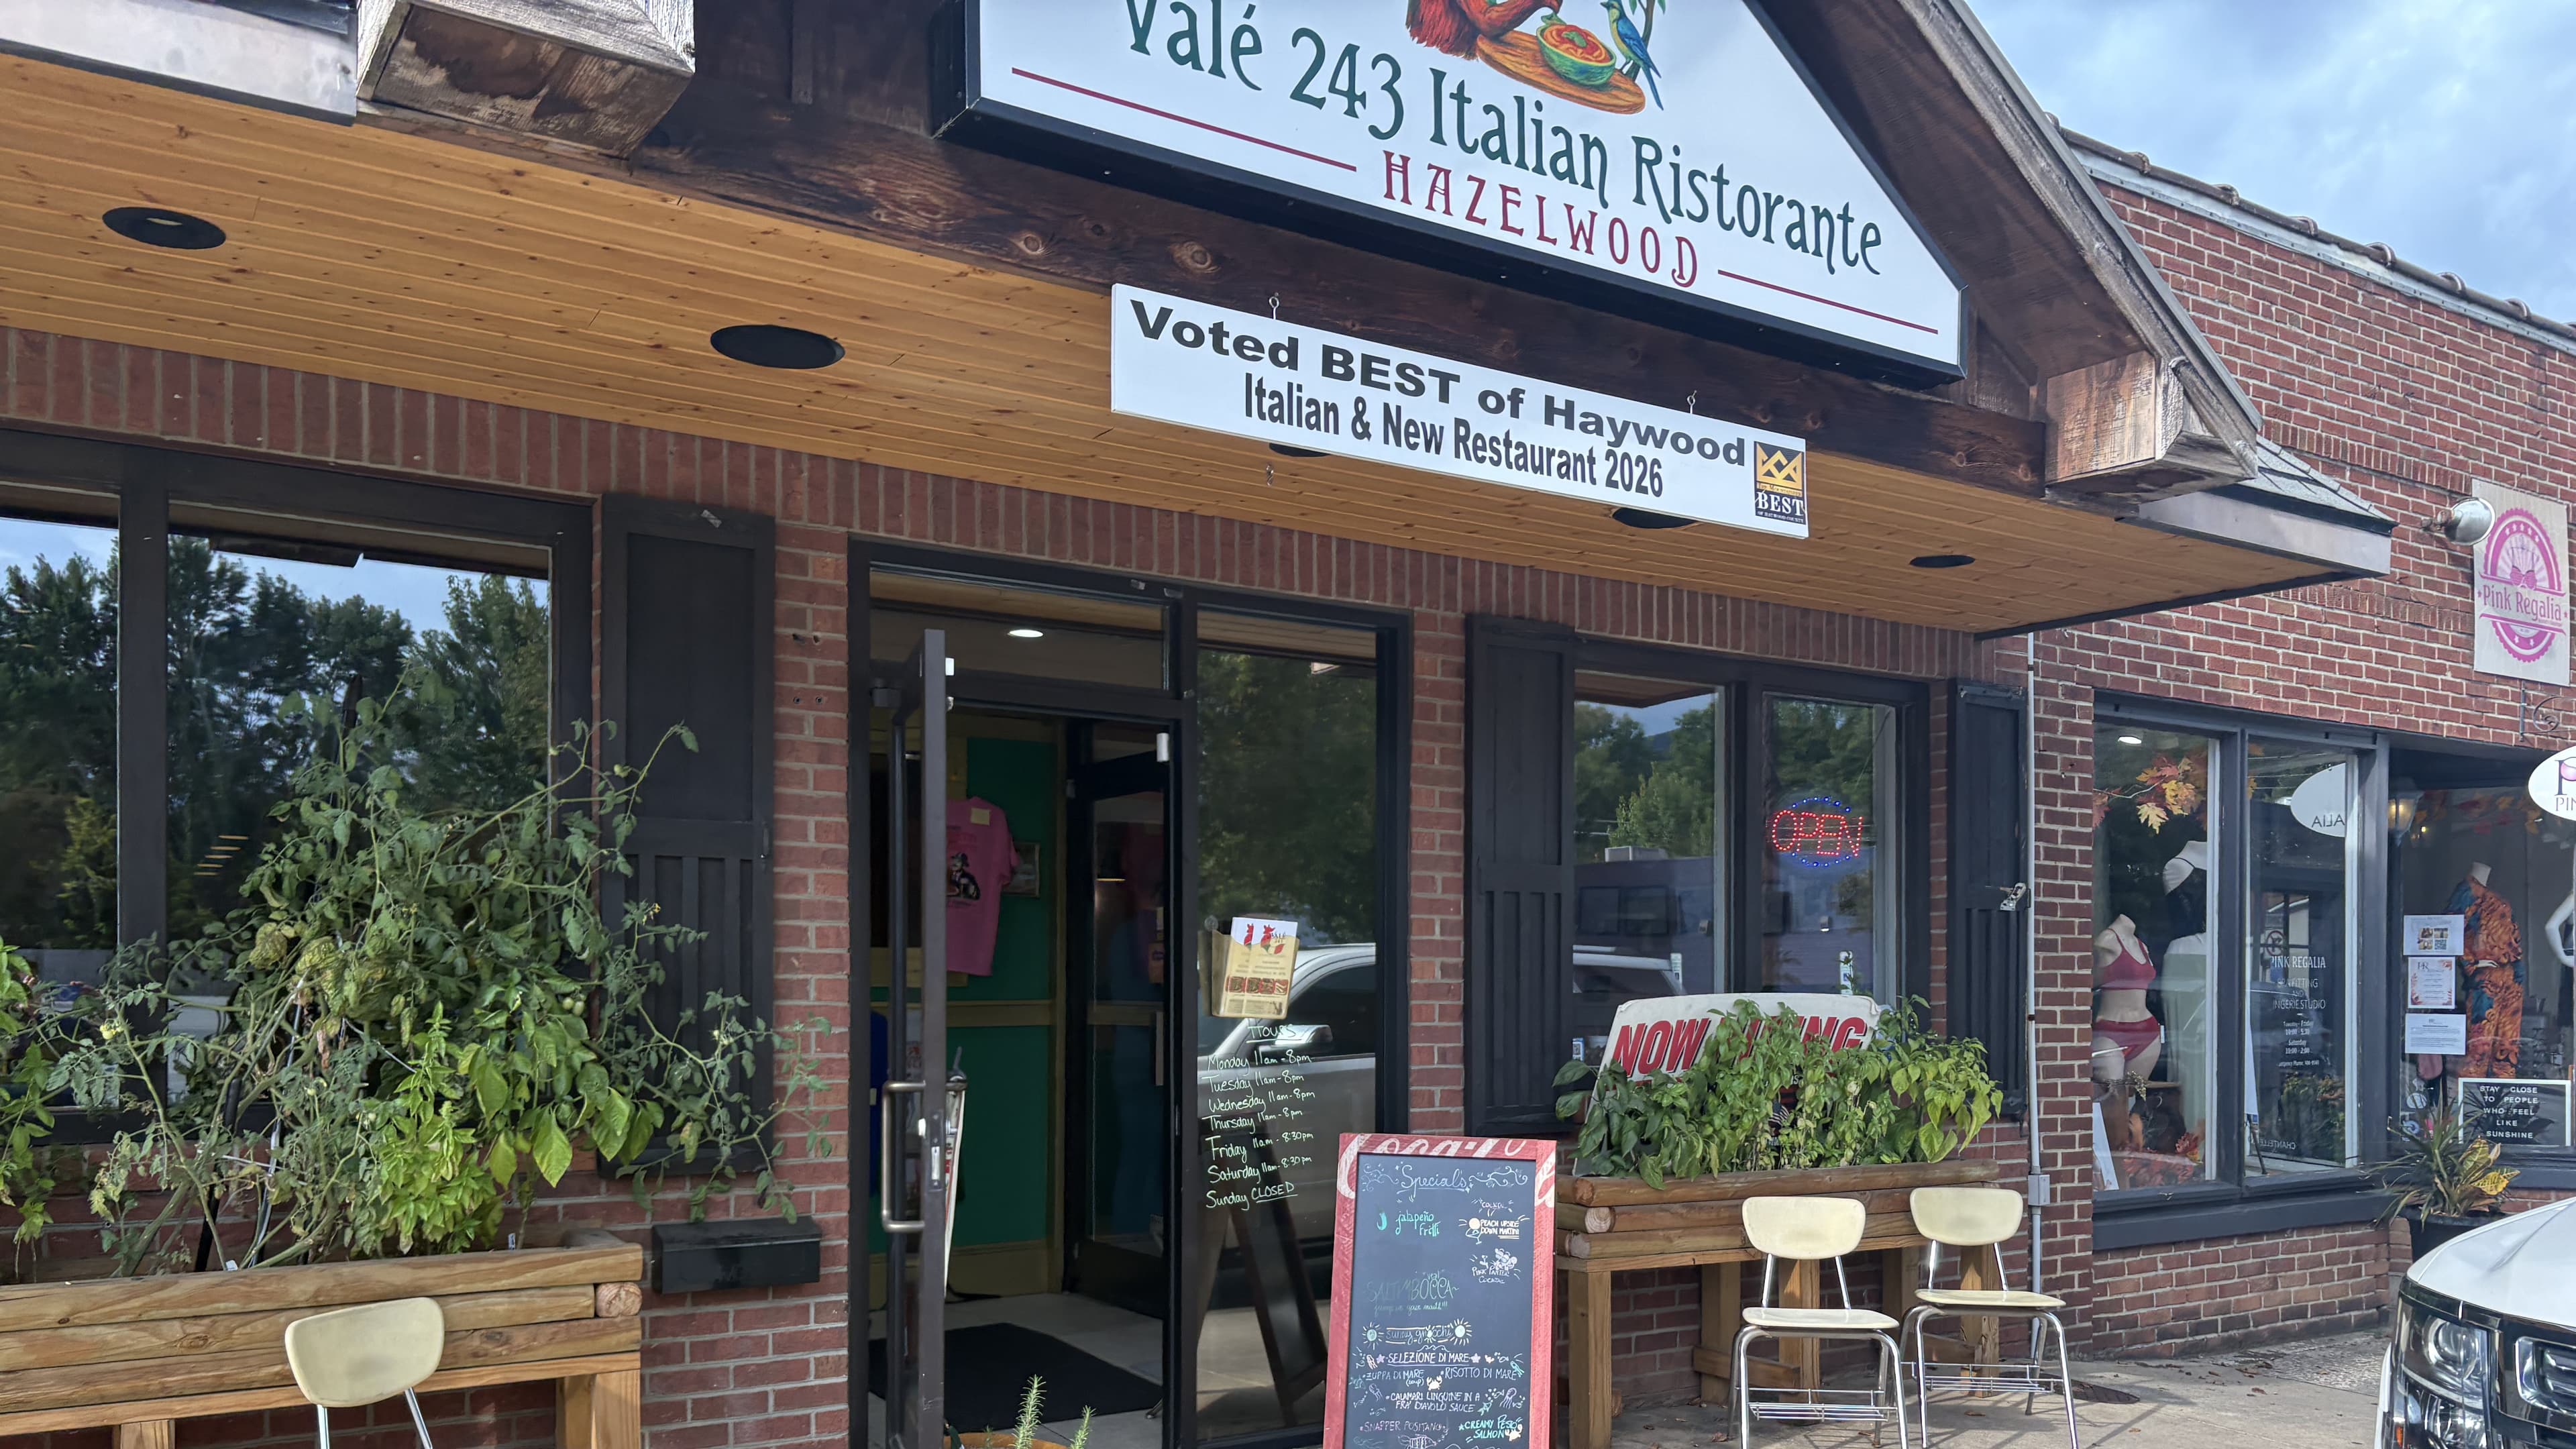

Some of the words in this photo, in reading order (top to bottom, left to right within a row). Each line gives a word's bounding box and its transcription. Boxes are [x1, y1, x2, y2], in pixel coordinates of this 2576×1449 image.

[1126, 0, 1263, 91] Valé
[1289, 28, 1405, 140] 243
[1429, 67, 1609, 209] Italian
[1631, 136, 1881, 275] Ristorante
[1383, 150, 1698, 288] HAZELWOOD
[1130, 299, 1299, 371] Voted
[1321, 343, 1460, 404] BEST
[1478, 388, 1526, 419] of
[1544, 394, 1746, 466] Haywood
[1244, 372, 1340, 435] Italian
[1351, 396, 1372, 442] &
[1383, 402, 1445, 455] New
[1454, 417, 1597, 486] Restaurant
[1605, 448, 1664, 498] 2026
[1756, 492, 1804, 516] BEST
[2483, 584, 2512, 610] Pink
[2516, 591, 2561, 621] Regalia
[2555, 797, 2576, 812] PIN
[1771, 809, 1864, 859] OPEN
[2292, 955, 2326, 969] REGALIA
[2273, 1000, 2301, 1010] INGERIE
[1612, 1017, 1711, 1077] NOW
[1208, 1054, 1250, 1077] Monday
[1201, 1074, 1254, 1097] Tuesday
[1208, 1096, 1267, 1114] Wednesday
[2504, 1096, 2538, 1104] PEOPLE
[1201, 1115, 1256, 1134] Thursday
[2486, 1130, 2533, 1139] SUNSHINE
[1205, 1135, 1247, 1163] Friday
[1208, 1165, 1261, 1184] Saturday
[1205, 1190, 1250, 1210] Sunday
[1251, 1181, 1295, 1200] CLOSED
[1395, 1210, 1434, 1236] jalapeño
[1480, 1219, 1499, 1227] PEACH
[1481, 1227, 1498, 1235] DOWN
[1388, 1352, 1436, 1364] SELEZIONE
[1438, 1352, 1446, 1362] DI
[1448, 1353, 1469, 1362] MARE
[1393, 1371, 1401, 1379] DI
[1403, 1369, 1425, 1379] MARE
[1445, 1367, 1480, 1379] RISOTTO
[1483, 1368, 1492, 1379] DI
[1495, 1368, 1517, 1381] MARE
[1427, 1391, 1462, 1402] LINGUINE
[1464, 1392, 1472, 1401] IN
[1475, 1393, 1481, 1401] A
[1415, 1402, 1447, 1411] DIAVOLO
[1449, 1403, 1476, 1412] SAUCE
[1364, 1420, 1401, 1432] SNAPPER
[1404, 1421, 1442, 1432] POSITANO
[1464, 1419, 1495, 1429] CREAMY
[1473, 1429, 1505, 1439] SALMON
